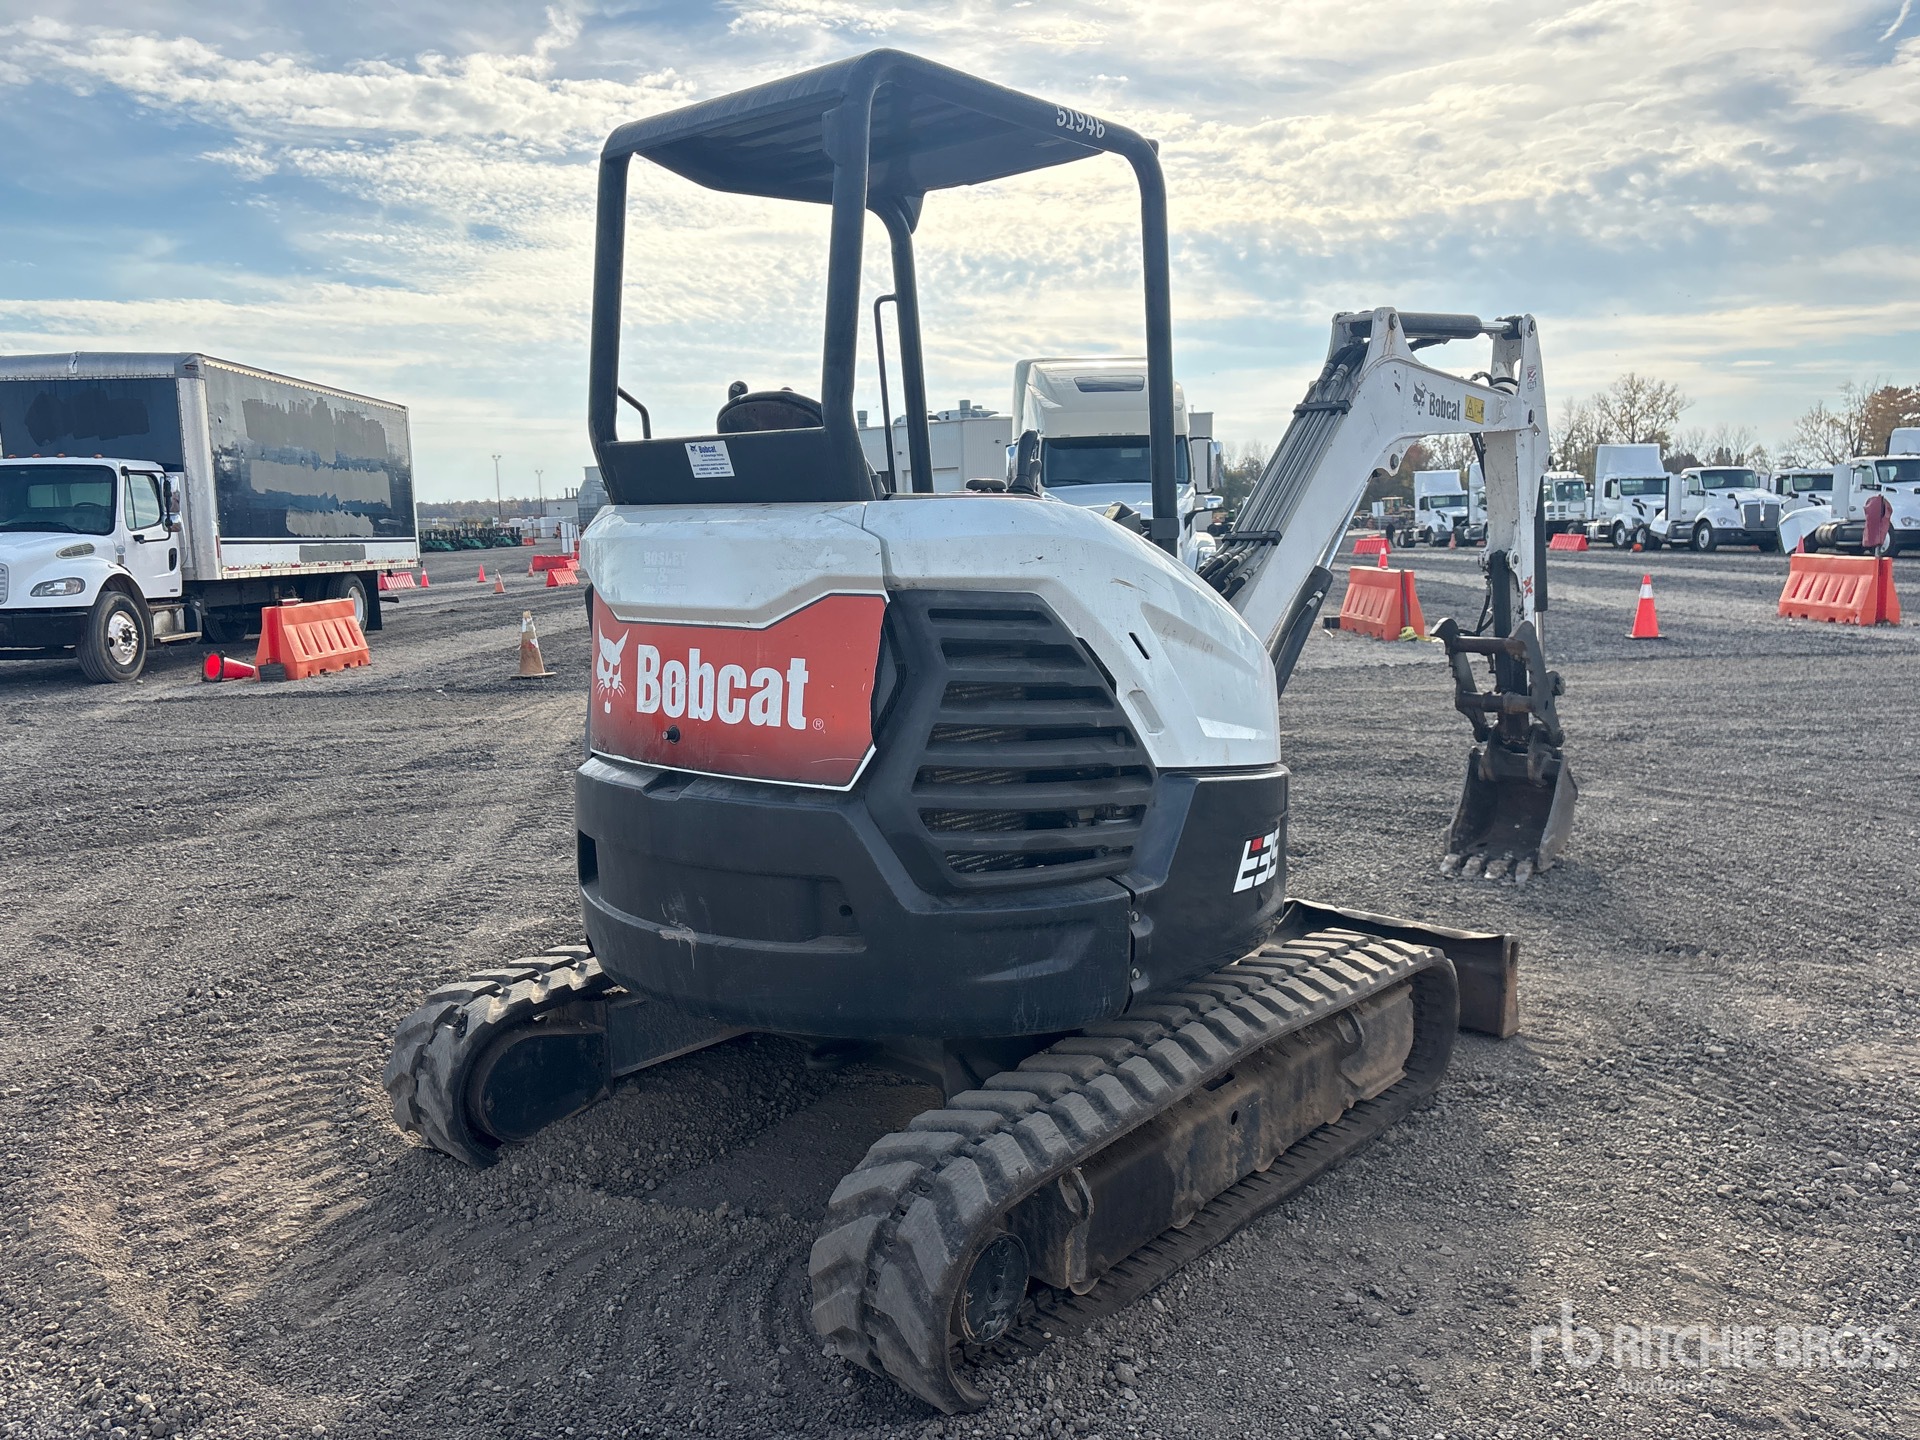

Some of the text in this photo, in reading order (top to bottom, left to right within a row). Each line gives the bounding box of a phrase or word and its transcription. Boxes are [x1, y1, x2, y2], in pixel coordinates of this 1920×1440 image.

[1056, 105, 1106, 139] 51946
[1428, 392, 1461, 422] Bobcat
[636, 644, 809, 730] Bobcat
